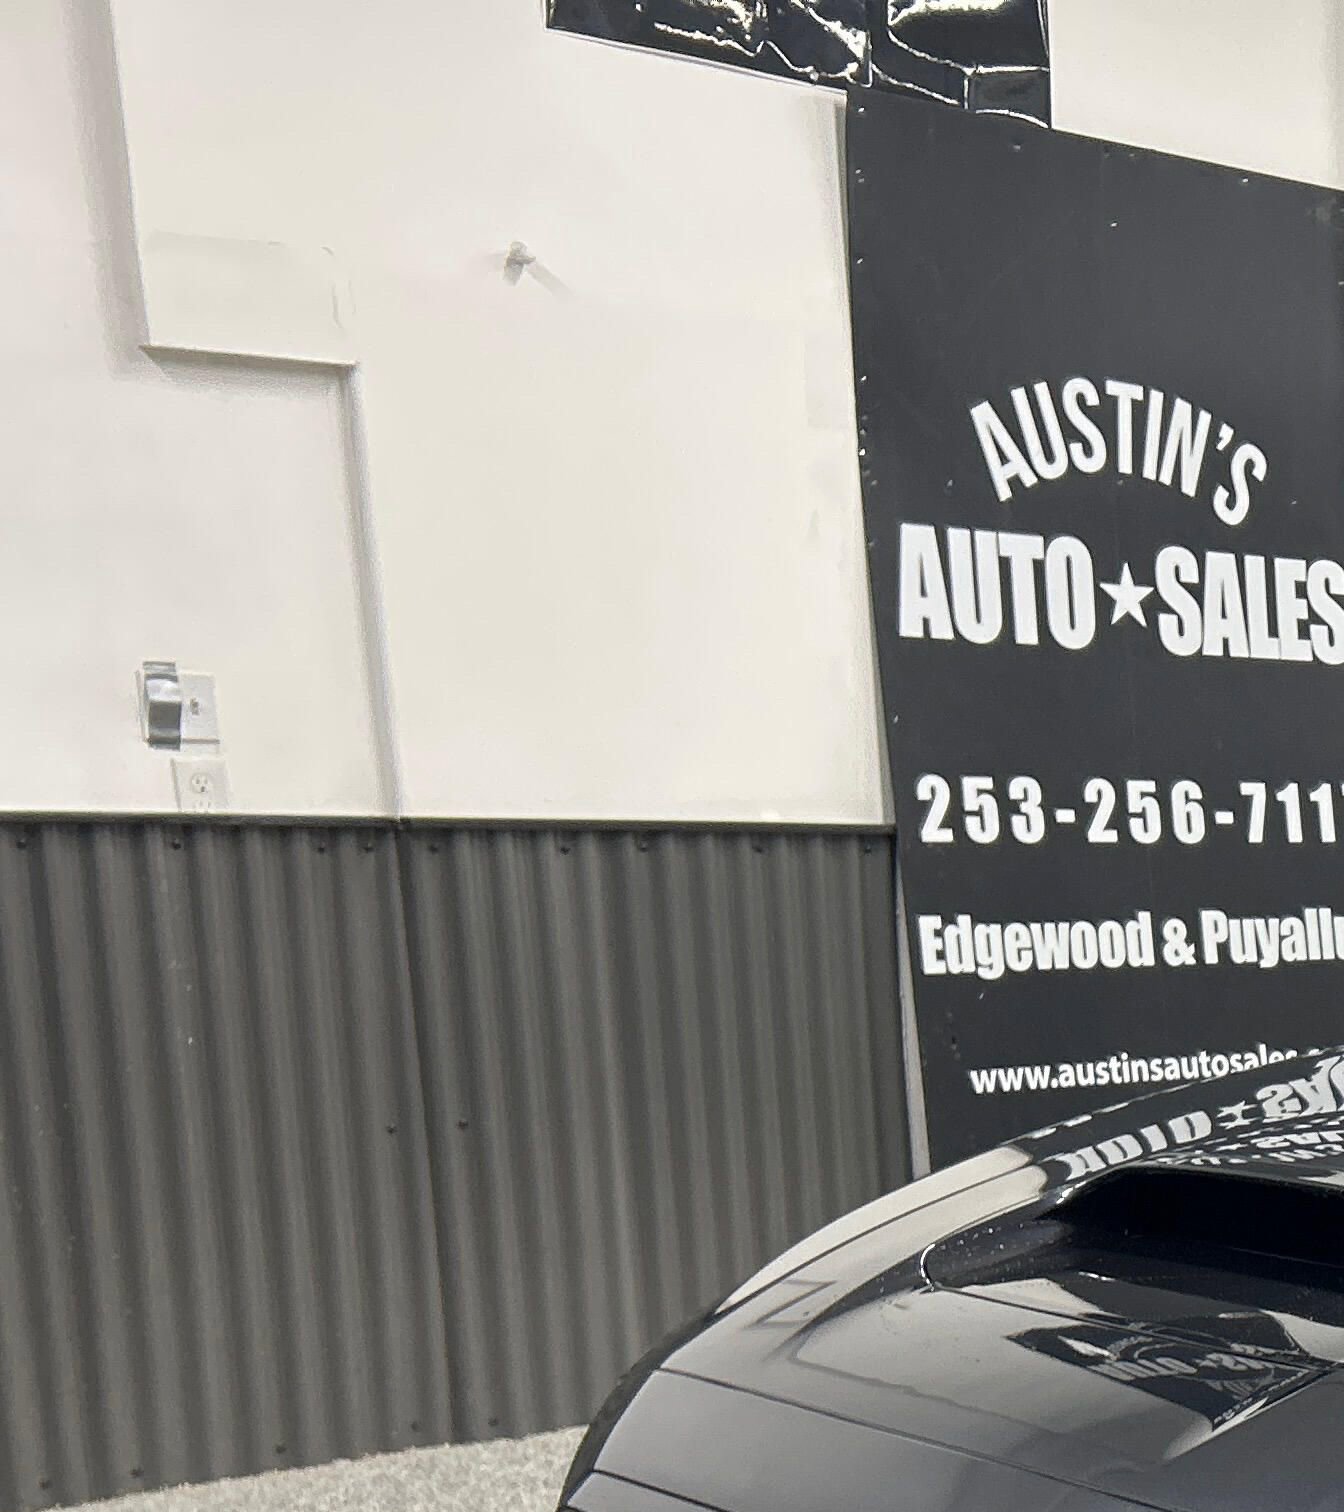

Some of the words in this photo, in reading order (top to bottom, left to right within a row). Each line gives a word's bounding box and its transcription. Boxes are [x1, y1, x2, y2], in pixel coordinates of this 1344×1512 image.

[970, 377, 1268, 526] AUSTIN'S
[899, 522, 1096, 650] AUTO
[918, 911, 1156, 980] Edgewood
[1162, 918, 1197, 968] &
